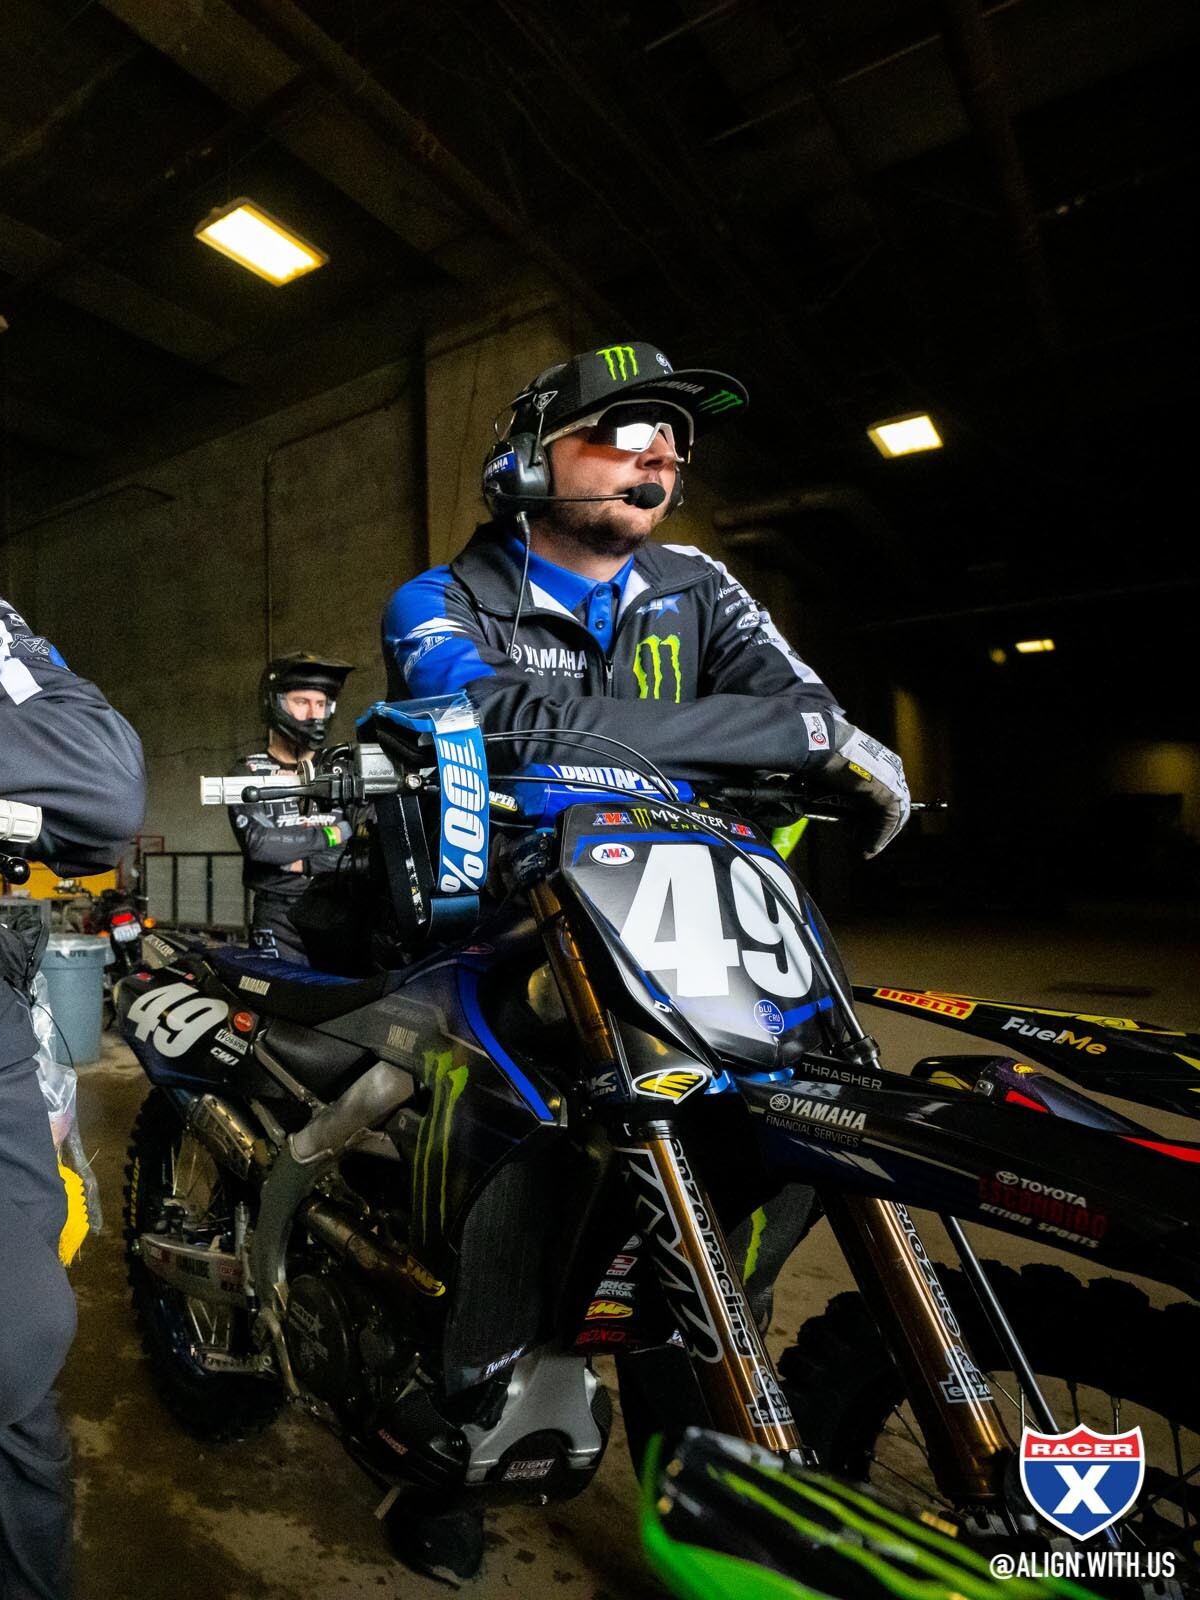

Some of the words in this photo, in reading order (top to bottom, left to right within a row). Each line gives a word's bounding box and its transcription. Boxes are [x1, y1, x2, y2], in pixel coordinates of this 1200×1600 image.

[524, 645, 587, 671] YAMAHA
[524, 667, 585, 679] ACING
[439, 737, 488, 896] 100%
[592, 812, 633, 827] AMA
[650, 808, 729, 830] MSTER
[729, 822, 757, 839] AMA
[601, 848, 629, 859] AMA
[619, 844, 814, 999] 49
[877, 988, 974, 1019] PIRELLI
[127, 982, 230, 1058] 49
[1001, 1015, 1108, 1056] FuelMe
[801, 1061, 883, 1090] THRASHER
[791, 1098, 868, 1131] YAMAHA
[765, 1114, 814, 1137] FINANCIAL
[813, 1125, 860, 1148] SERVICES
[1019, 1177, 1088, 1209] TOYOTA
[978, 1202, 1033, 1226] ACTION
[1036, 1221, 1101, 1249] SPORTS
